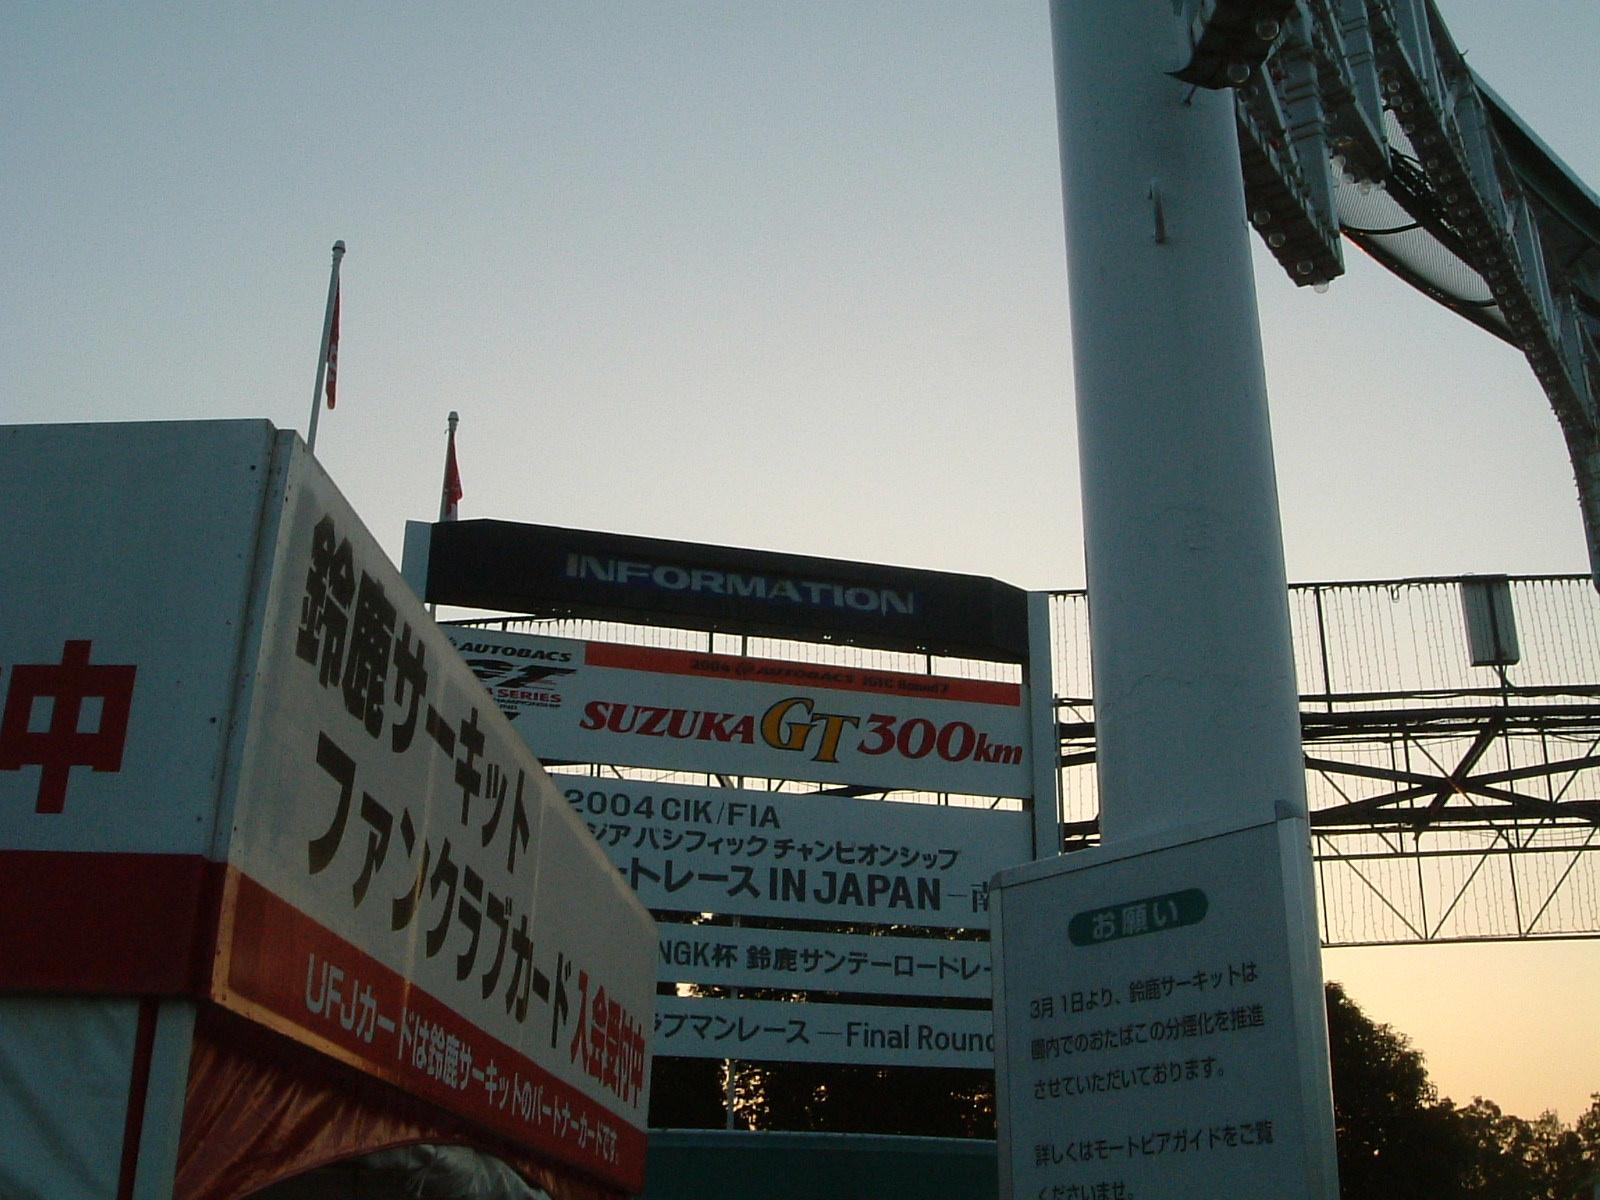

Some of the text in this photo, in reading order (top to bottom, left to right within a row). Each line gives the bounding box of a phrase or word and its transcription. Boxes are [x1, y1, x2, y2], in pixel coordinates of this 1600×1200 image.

[564, 552, 915, 616] INFORMATION
[458, 641, 573, 663] AUTOBACS
[295, 513, 531, 876] 鈴鹿サーキット
[497, 688, 562, 704] SERIES
[578, 697, 1023, 766] SUZUKA GT 300km
[564, 788, 781, 831] 2004 CIK/FIA
[813, 872, 942, 912] JAPAN
[1091, 899, 1179, 940] お願い
